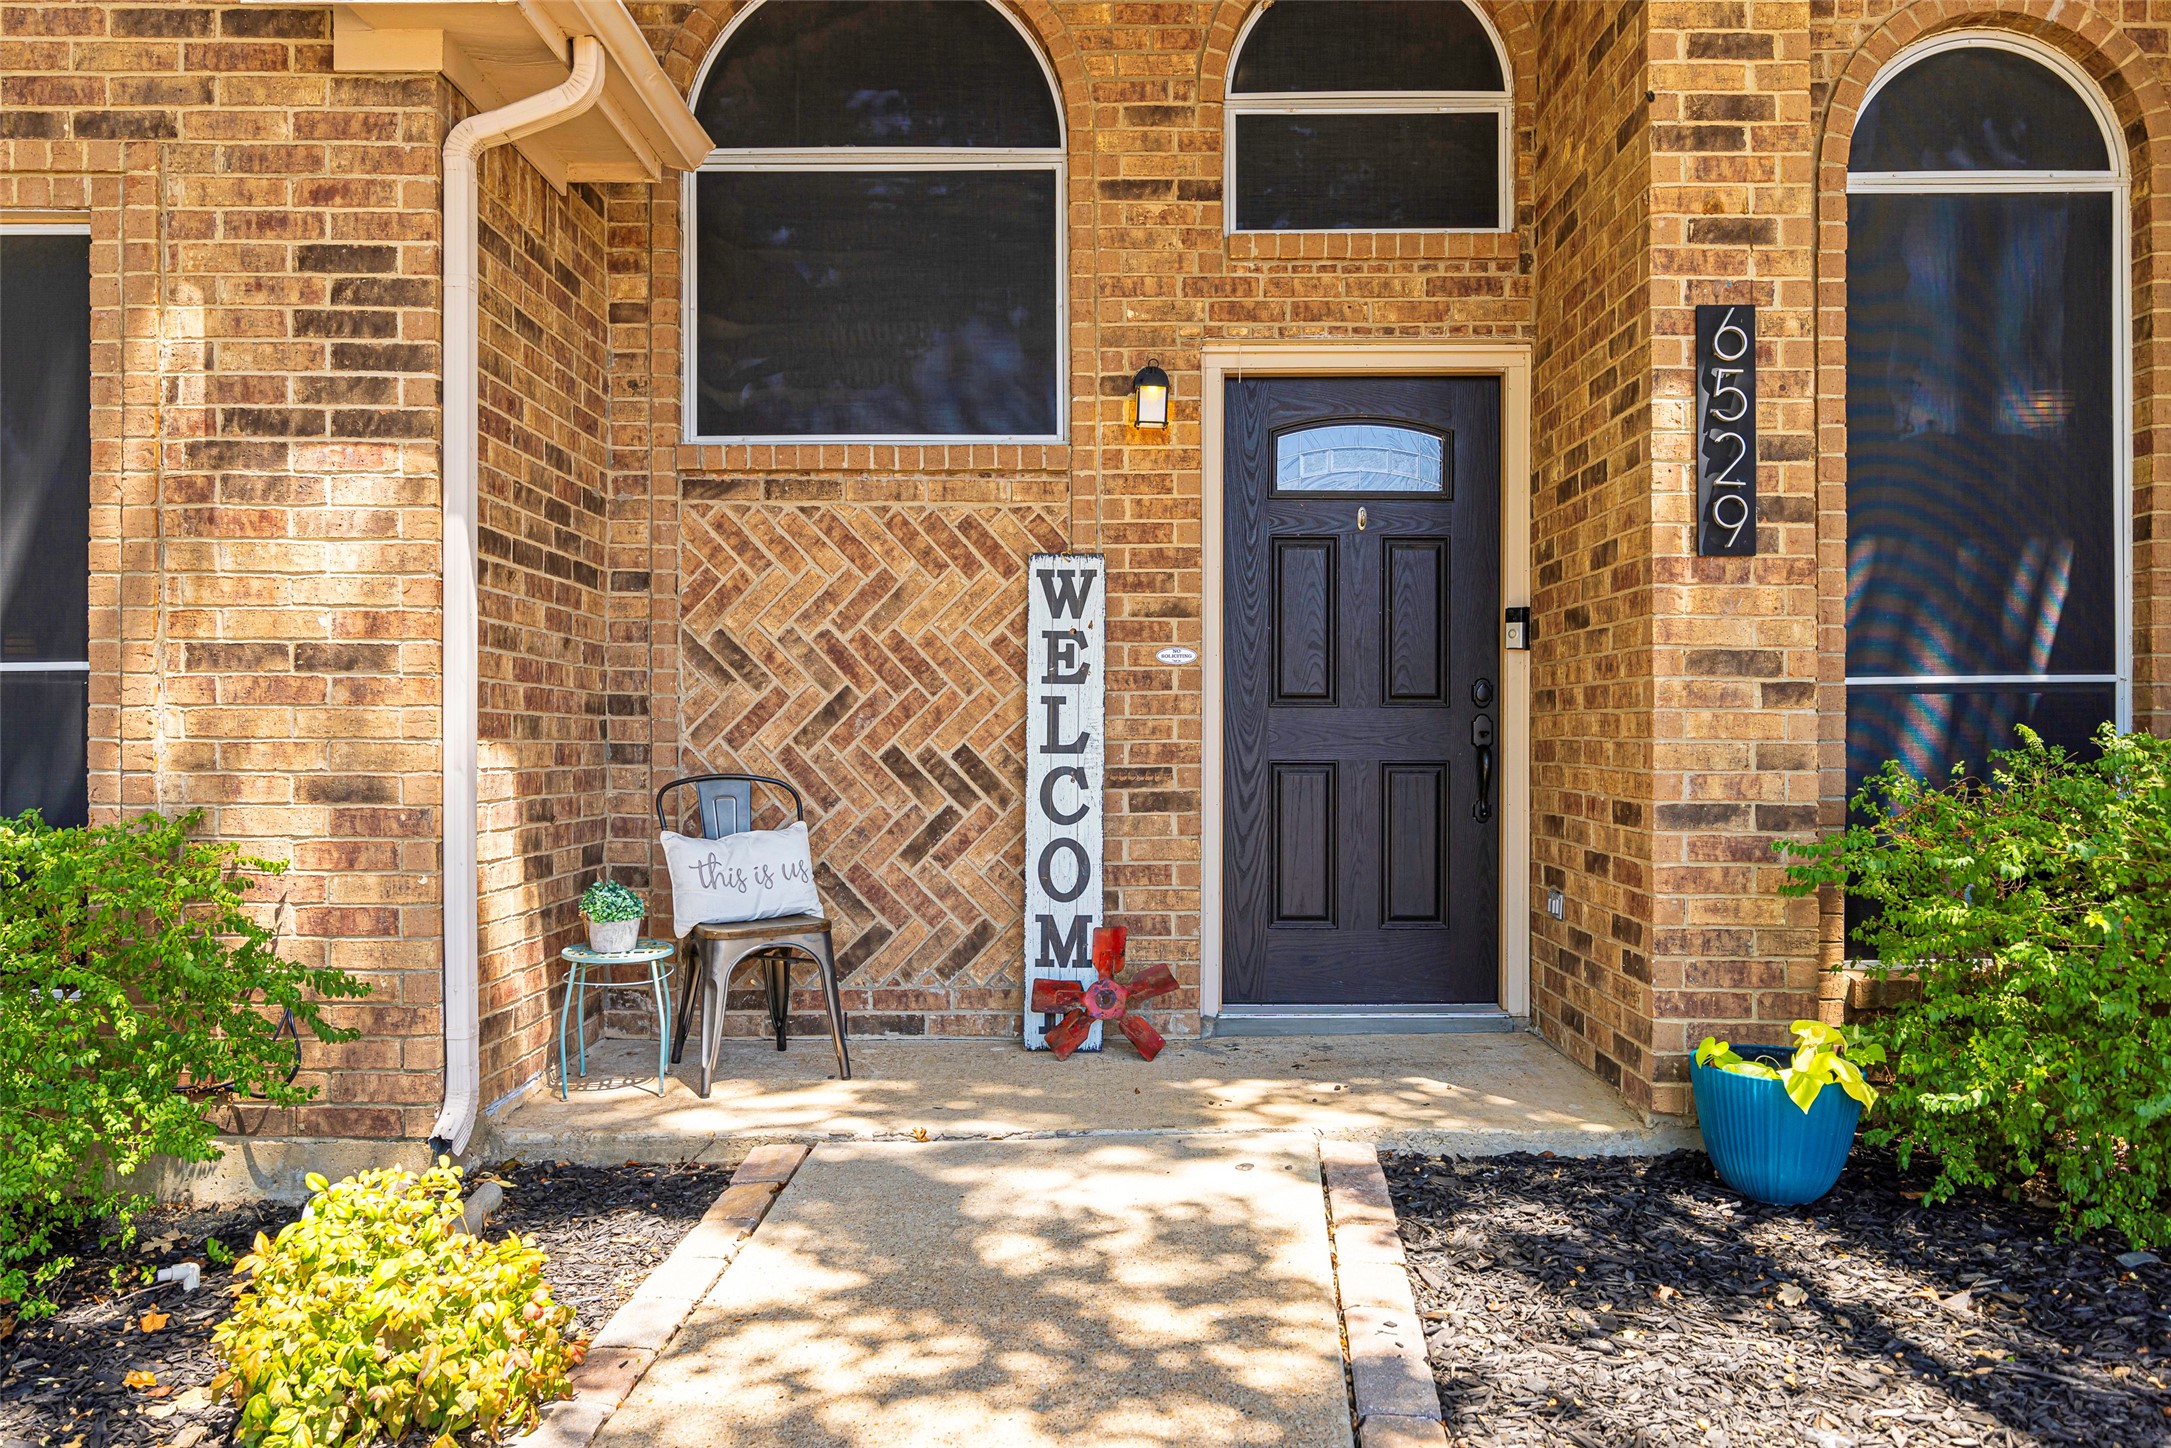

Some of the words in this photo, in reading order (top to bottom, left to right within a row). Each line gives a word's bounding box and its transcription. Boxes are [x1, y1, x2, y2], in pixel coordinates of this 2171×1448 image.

[1714, 307, 1748, 548] 6529
[689, 852, 747, 893] this
[754, 864, 774, 889] is
[782, 859, 808, 883] us
[1035, 568, 1097, 1035] WELCOM
